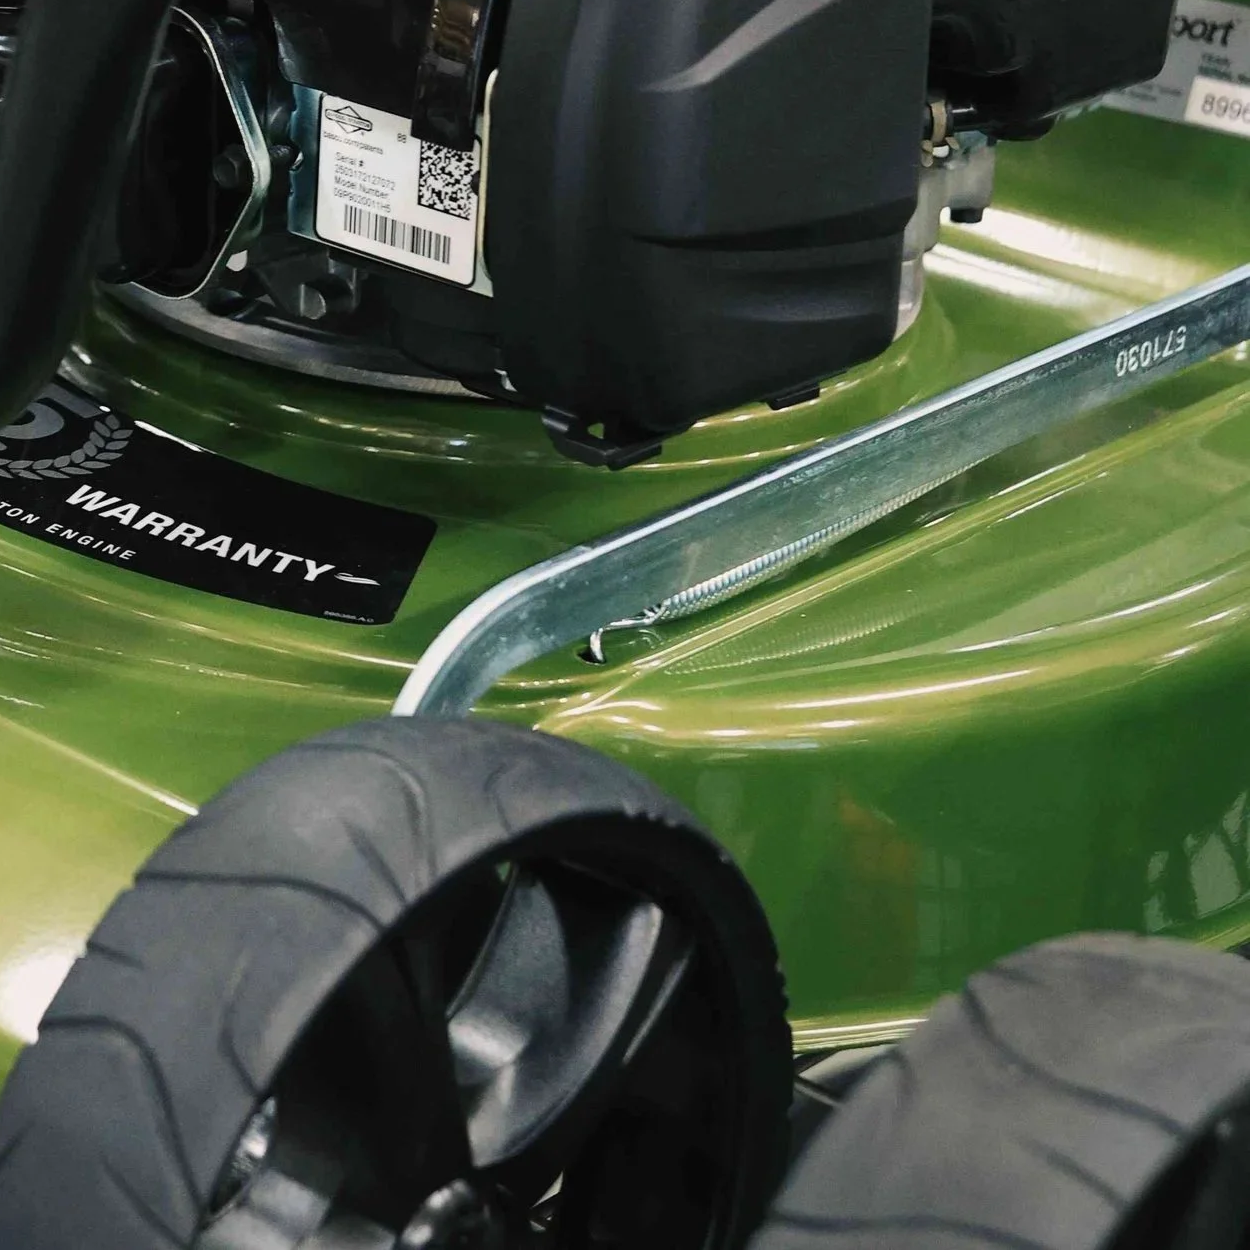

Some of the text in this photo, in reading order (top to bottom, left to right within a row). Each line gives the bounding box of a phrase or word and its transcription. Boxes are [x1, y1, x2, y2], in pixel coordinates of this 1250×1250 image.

[334, 175, 357, 190] Model
[1115, 325, 1187, 377] 571030
[45, 523, 137, 561] ENGINE
[65, 484, 336, 582] WARRANTY
